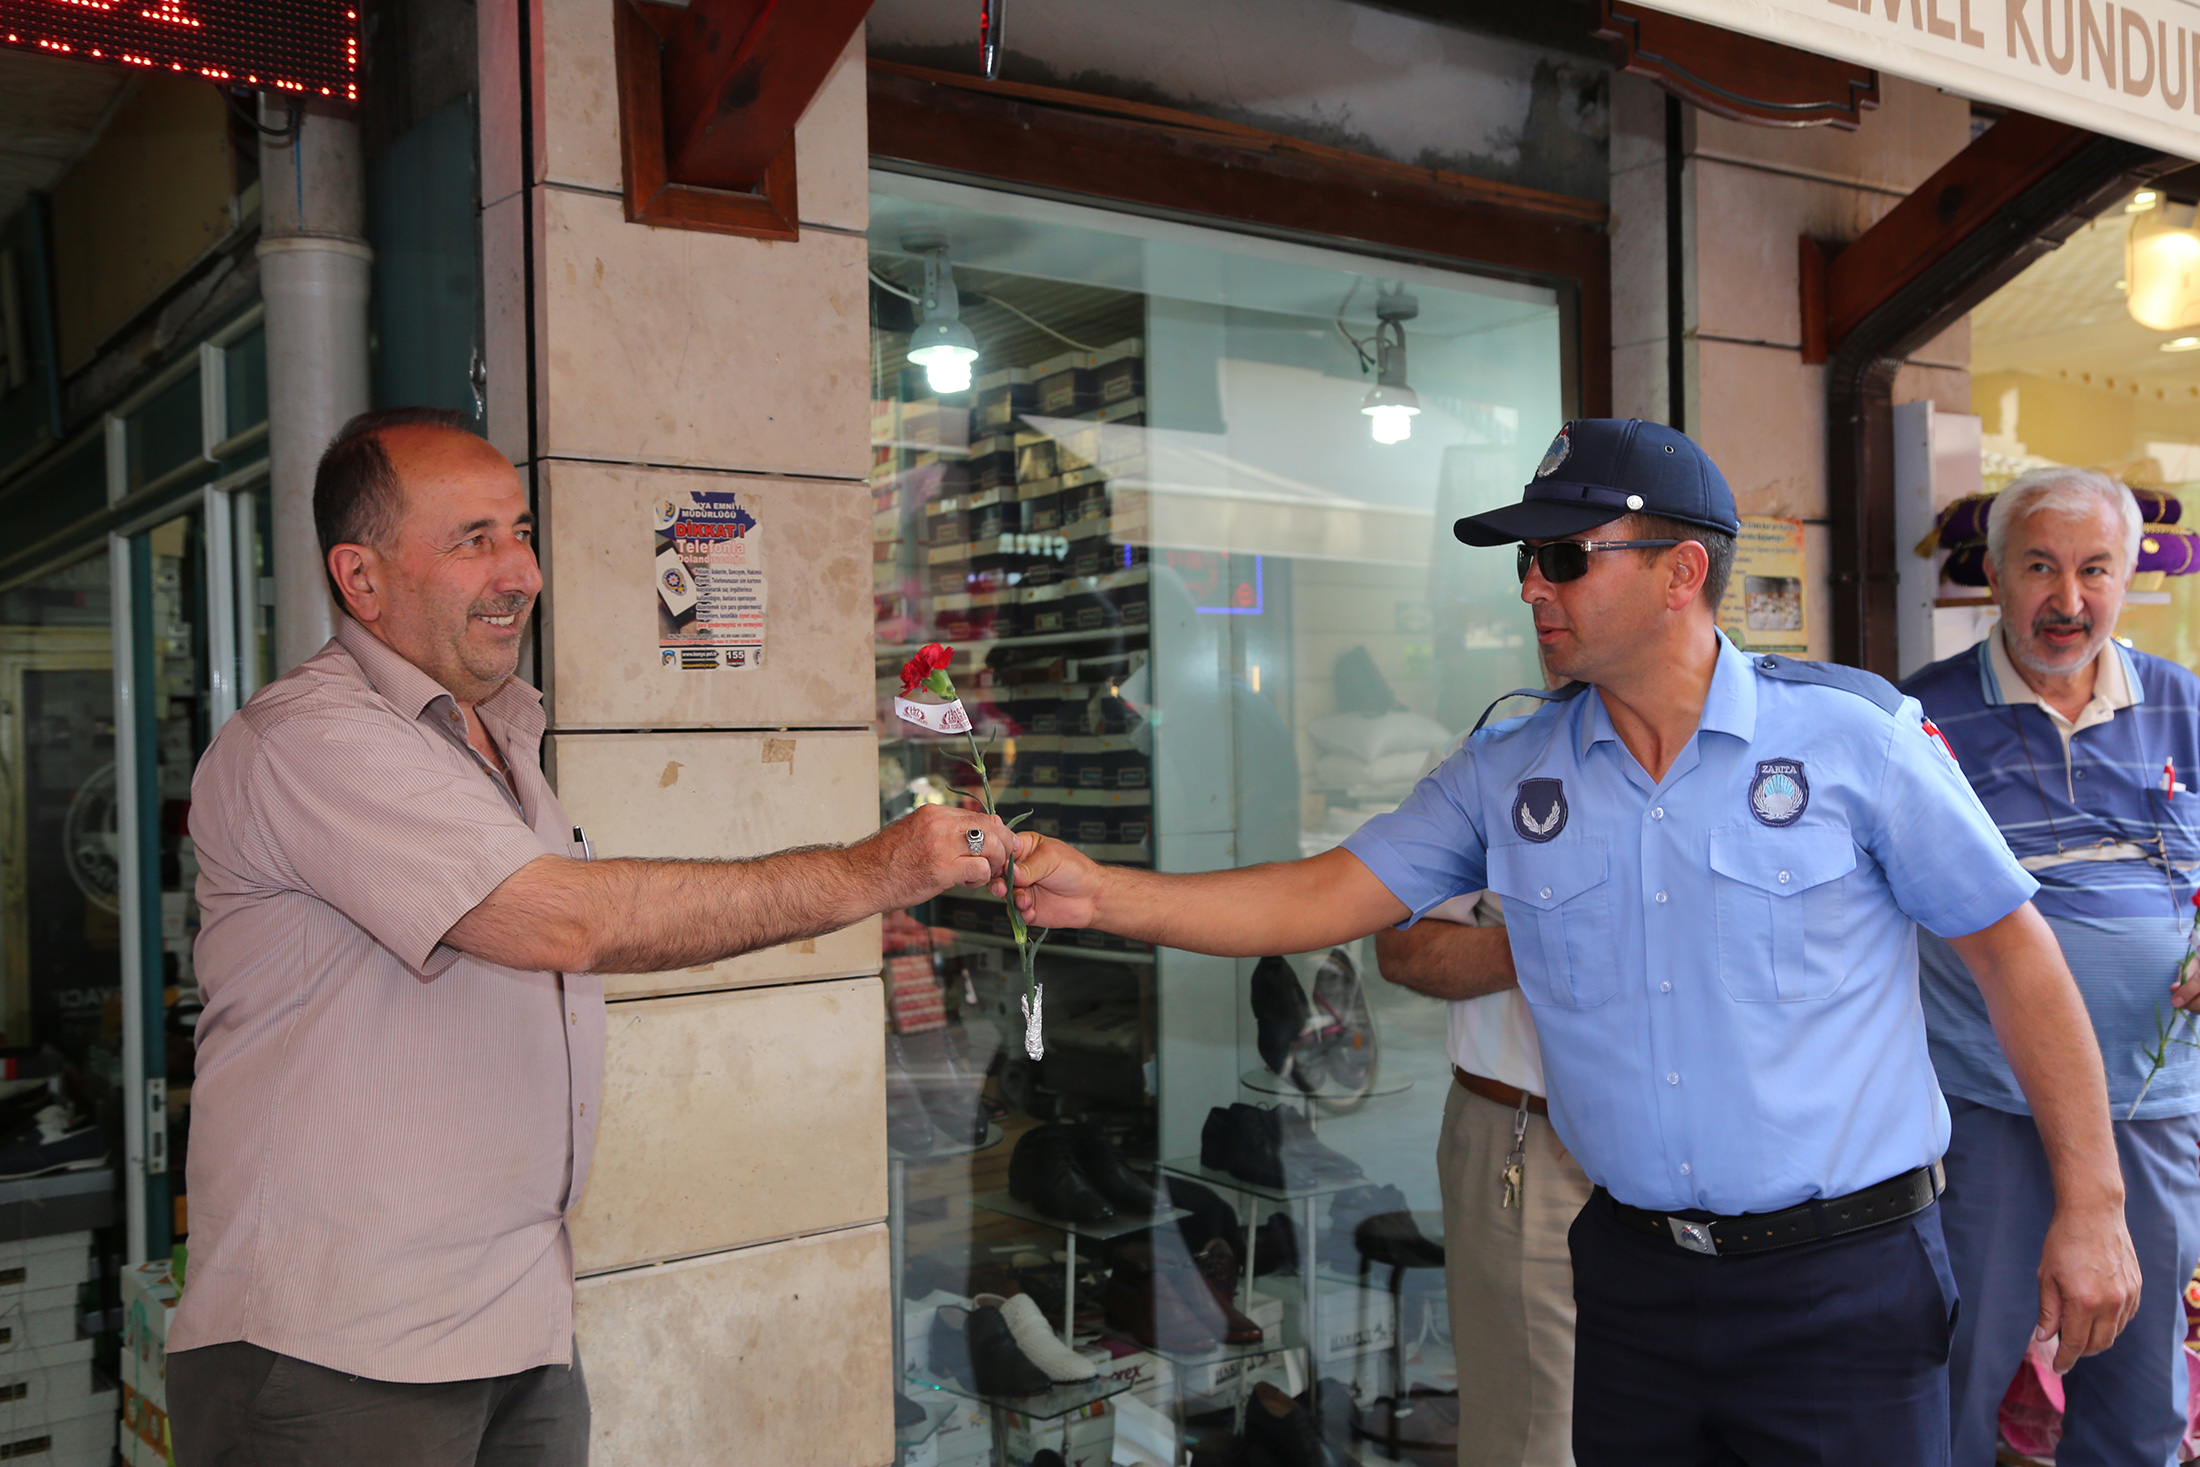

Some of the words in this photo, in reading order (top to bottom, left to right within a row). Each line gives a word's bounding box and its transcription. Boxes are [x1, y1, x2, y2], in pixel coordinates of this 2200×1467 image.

[2006, 0, 2200, 116] KUNDU
[681, 510, 737, 518] MÜDÜRLÜĞÜ
[675, 520, 735, 538] DİKKAT
[676, 539, 746, 554] Telefonla
[726, 651, 744, 660] 155
[1761, 764, 1798, 774] ZABITA
